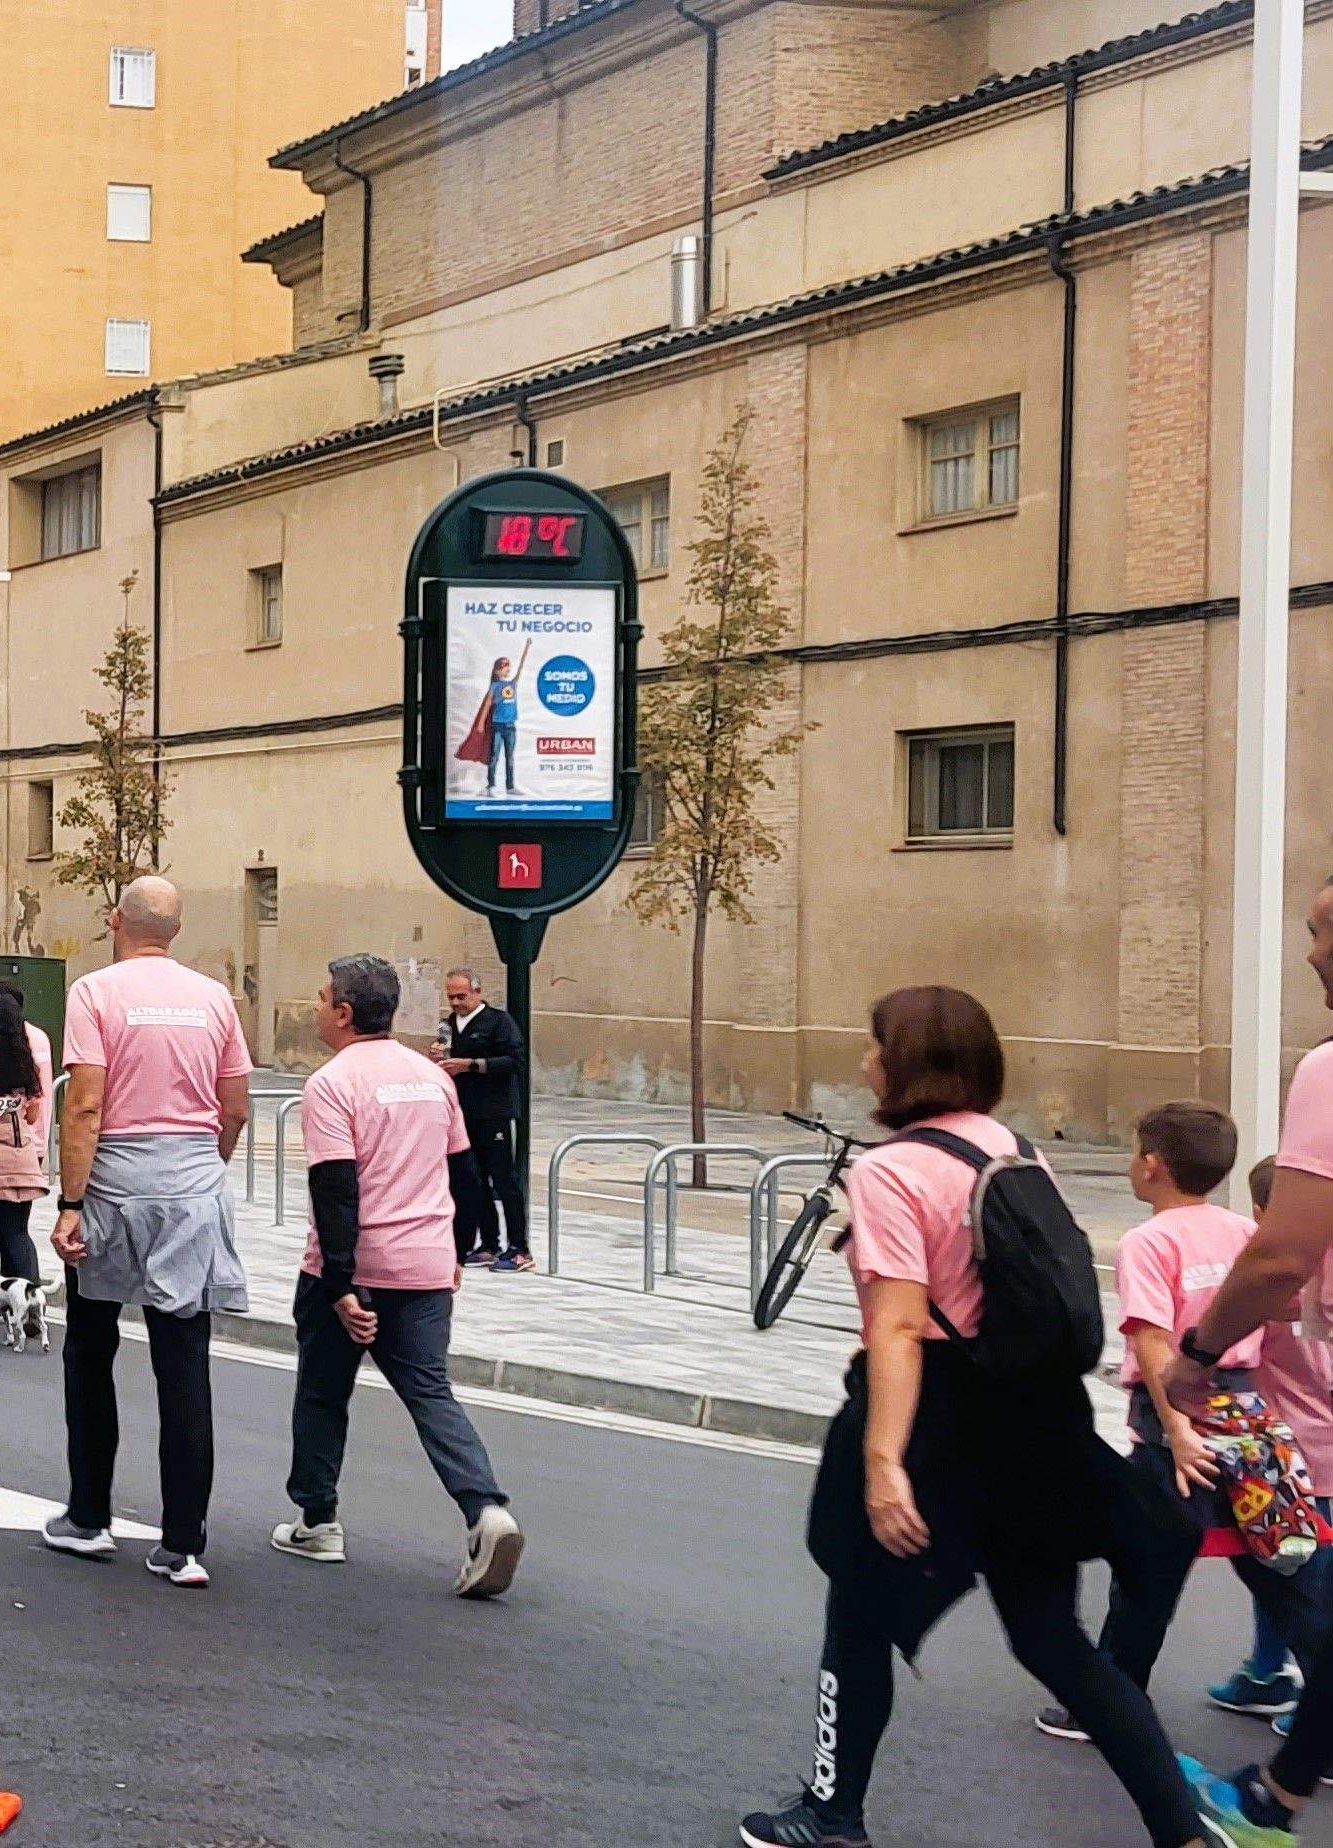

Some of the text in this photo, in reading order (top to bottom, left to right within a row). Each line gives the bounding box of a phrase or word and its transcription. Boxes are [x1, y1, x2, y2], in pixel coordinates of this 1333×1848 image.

[465, 603, 563, 615] HAZ CRECER
[496, 620, 593, 632] TU NEGOCIO
[544, 671, 588, 681] SOMOS
[559, 683, 575, 692] TU
[546, 694, 586, 703] MEDIO
[538, 740, 594, 750] URBAN
[810, 1669, 839, 1802] adidas
